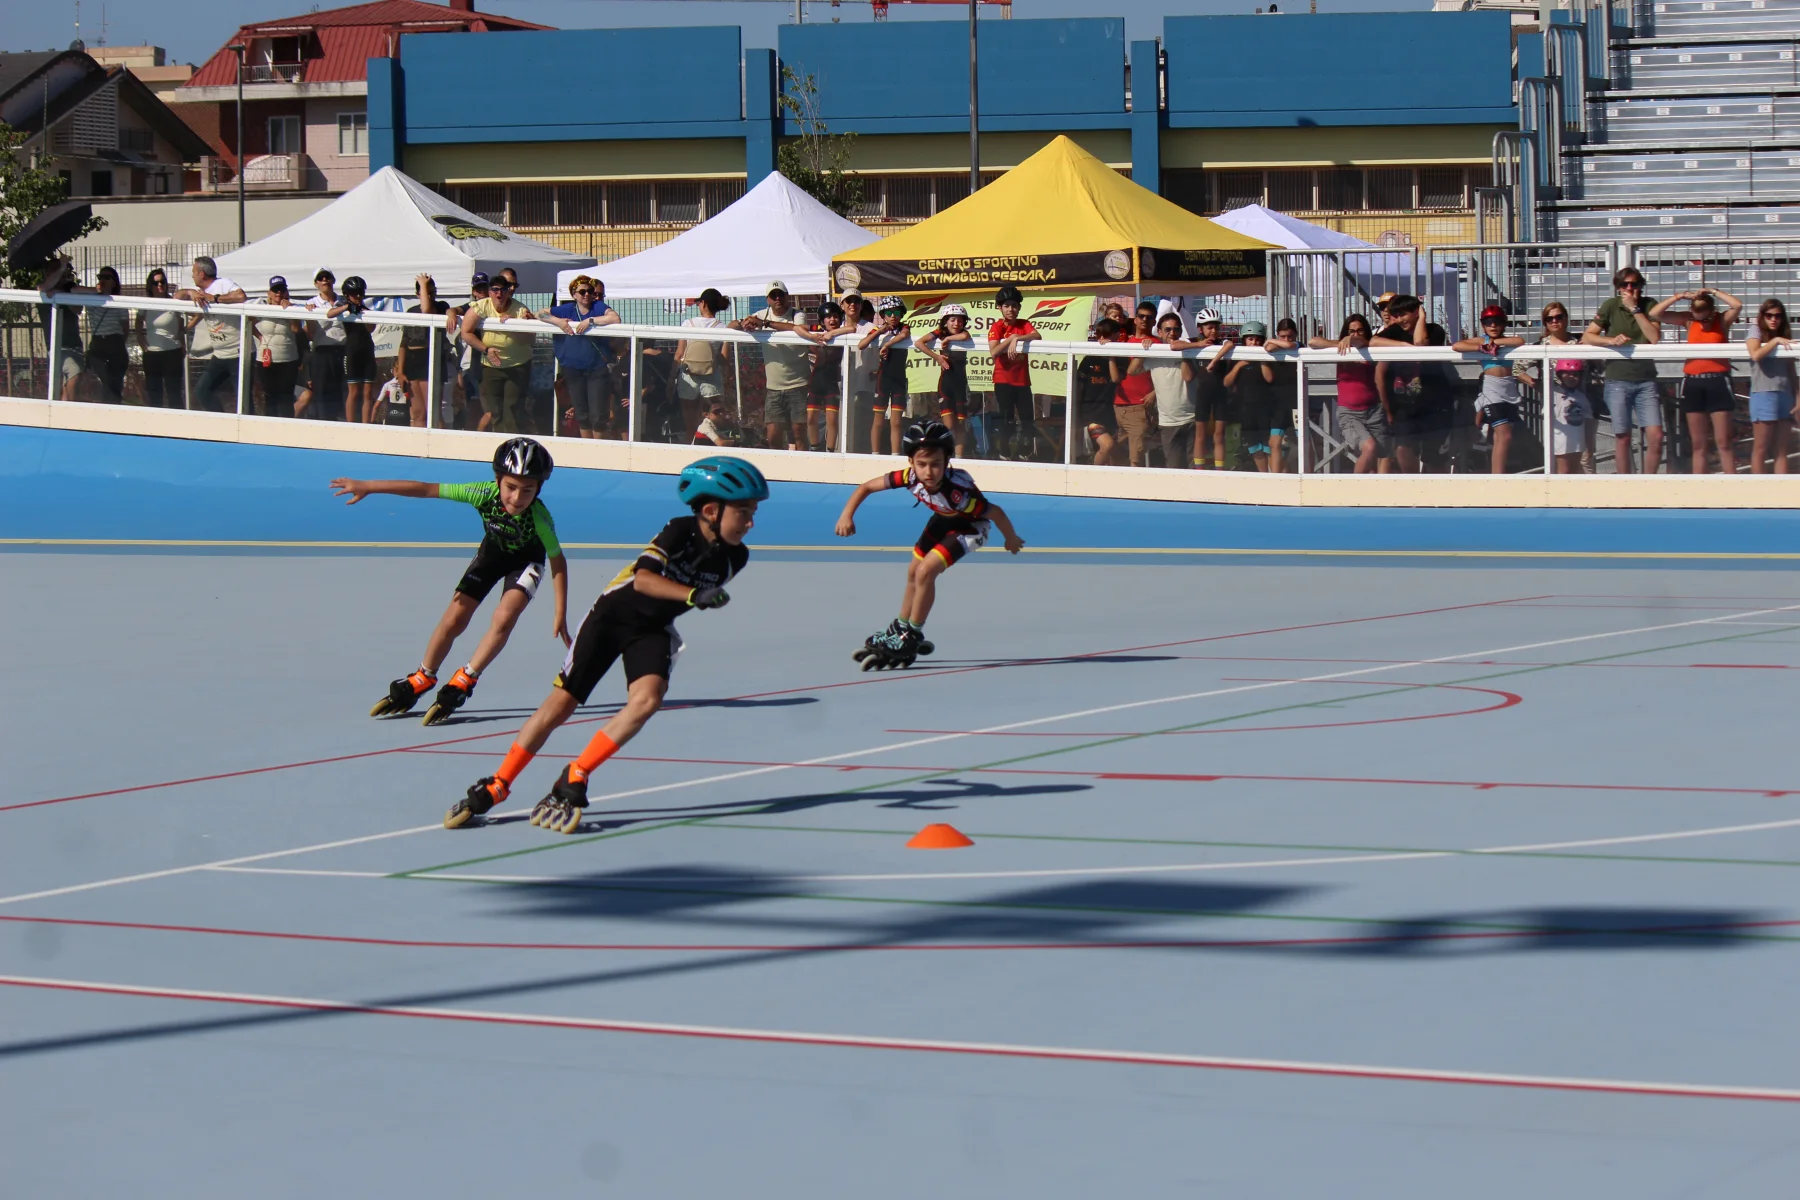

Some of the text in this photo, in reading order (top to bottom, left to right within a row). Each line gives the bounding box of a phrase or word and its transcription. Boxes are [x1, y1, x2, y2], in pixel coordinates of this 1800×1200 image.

[918, 255, 1039, 271] CENTRO SPORTIVO
[906, 268, 1057, 286] PATTINAGGIO PESCARA
[394, 391, 401, 402] 6
